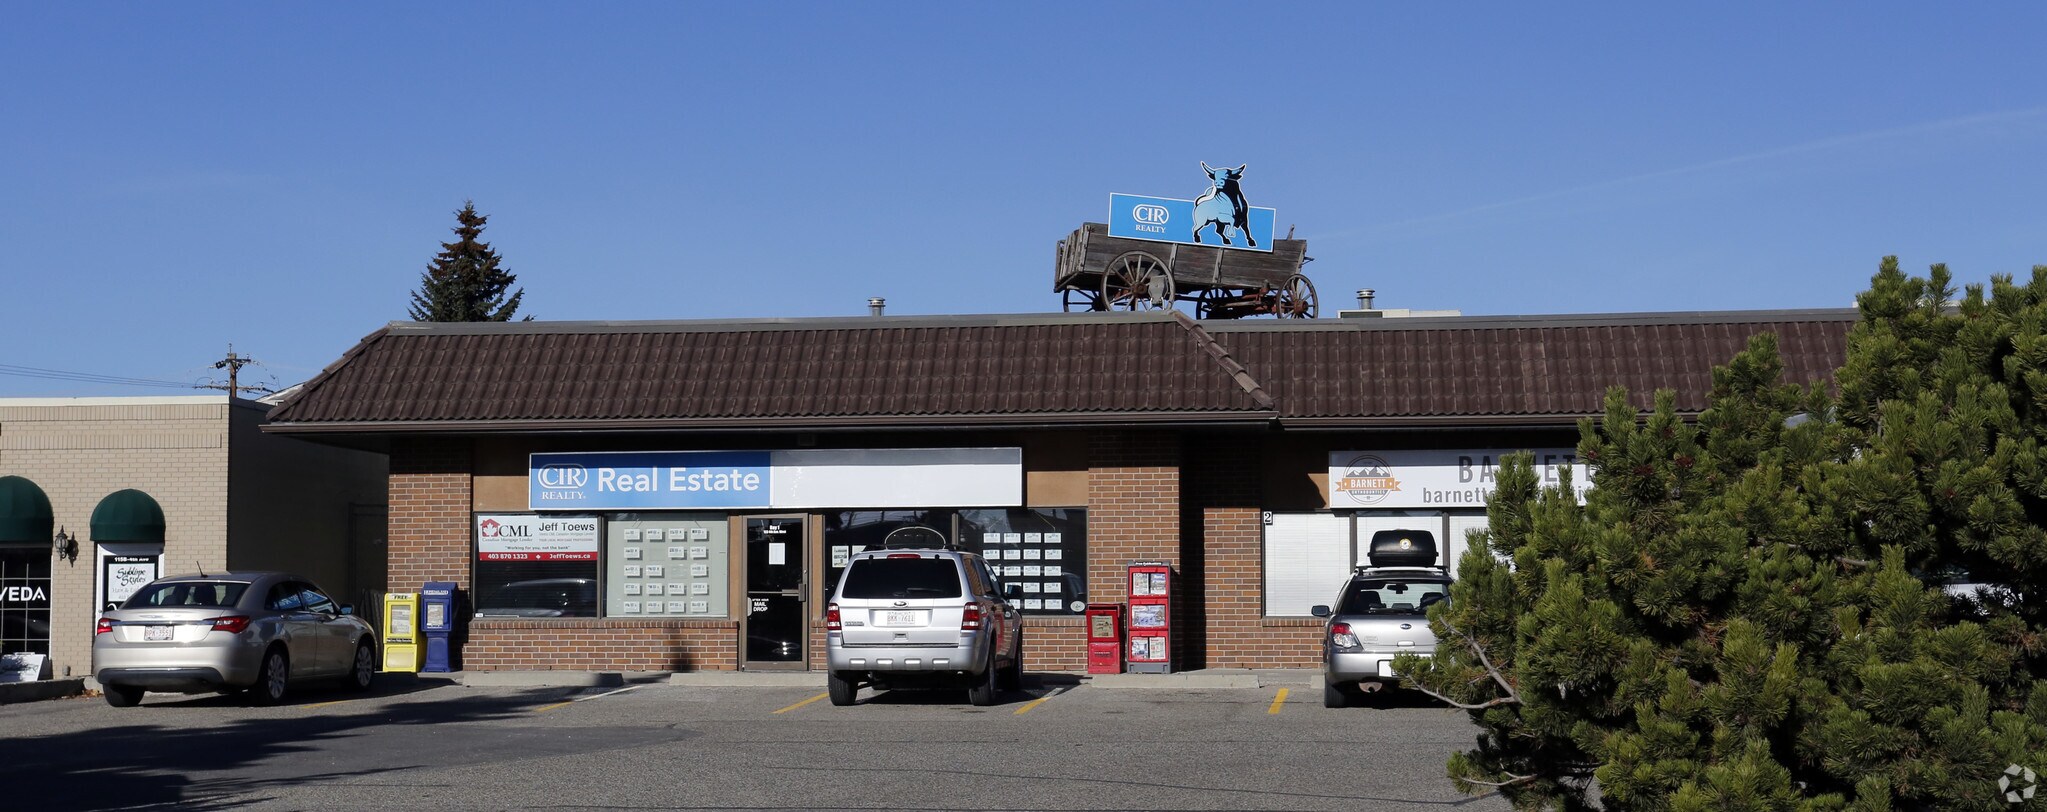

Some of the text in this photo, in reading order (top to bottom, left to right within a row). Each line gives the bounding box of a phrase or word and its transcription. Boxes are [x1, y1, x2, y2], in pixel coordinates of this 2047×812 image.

[1135, 206, 1165, 223] CIR
[1135, 224, 1166, 233] REALTY
[542, 467, 580, 486] CIR
[598, 467, 760, 492] Real Estate
[1351, 479, 1386, 488] BARNETT
[542, 491, 584, 500] REALTY
[1264, 512, 1272, 523] 2
[499, 525, 533, 538] CML
[539, 522, 595, 532] Jeff Toews
